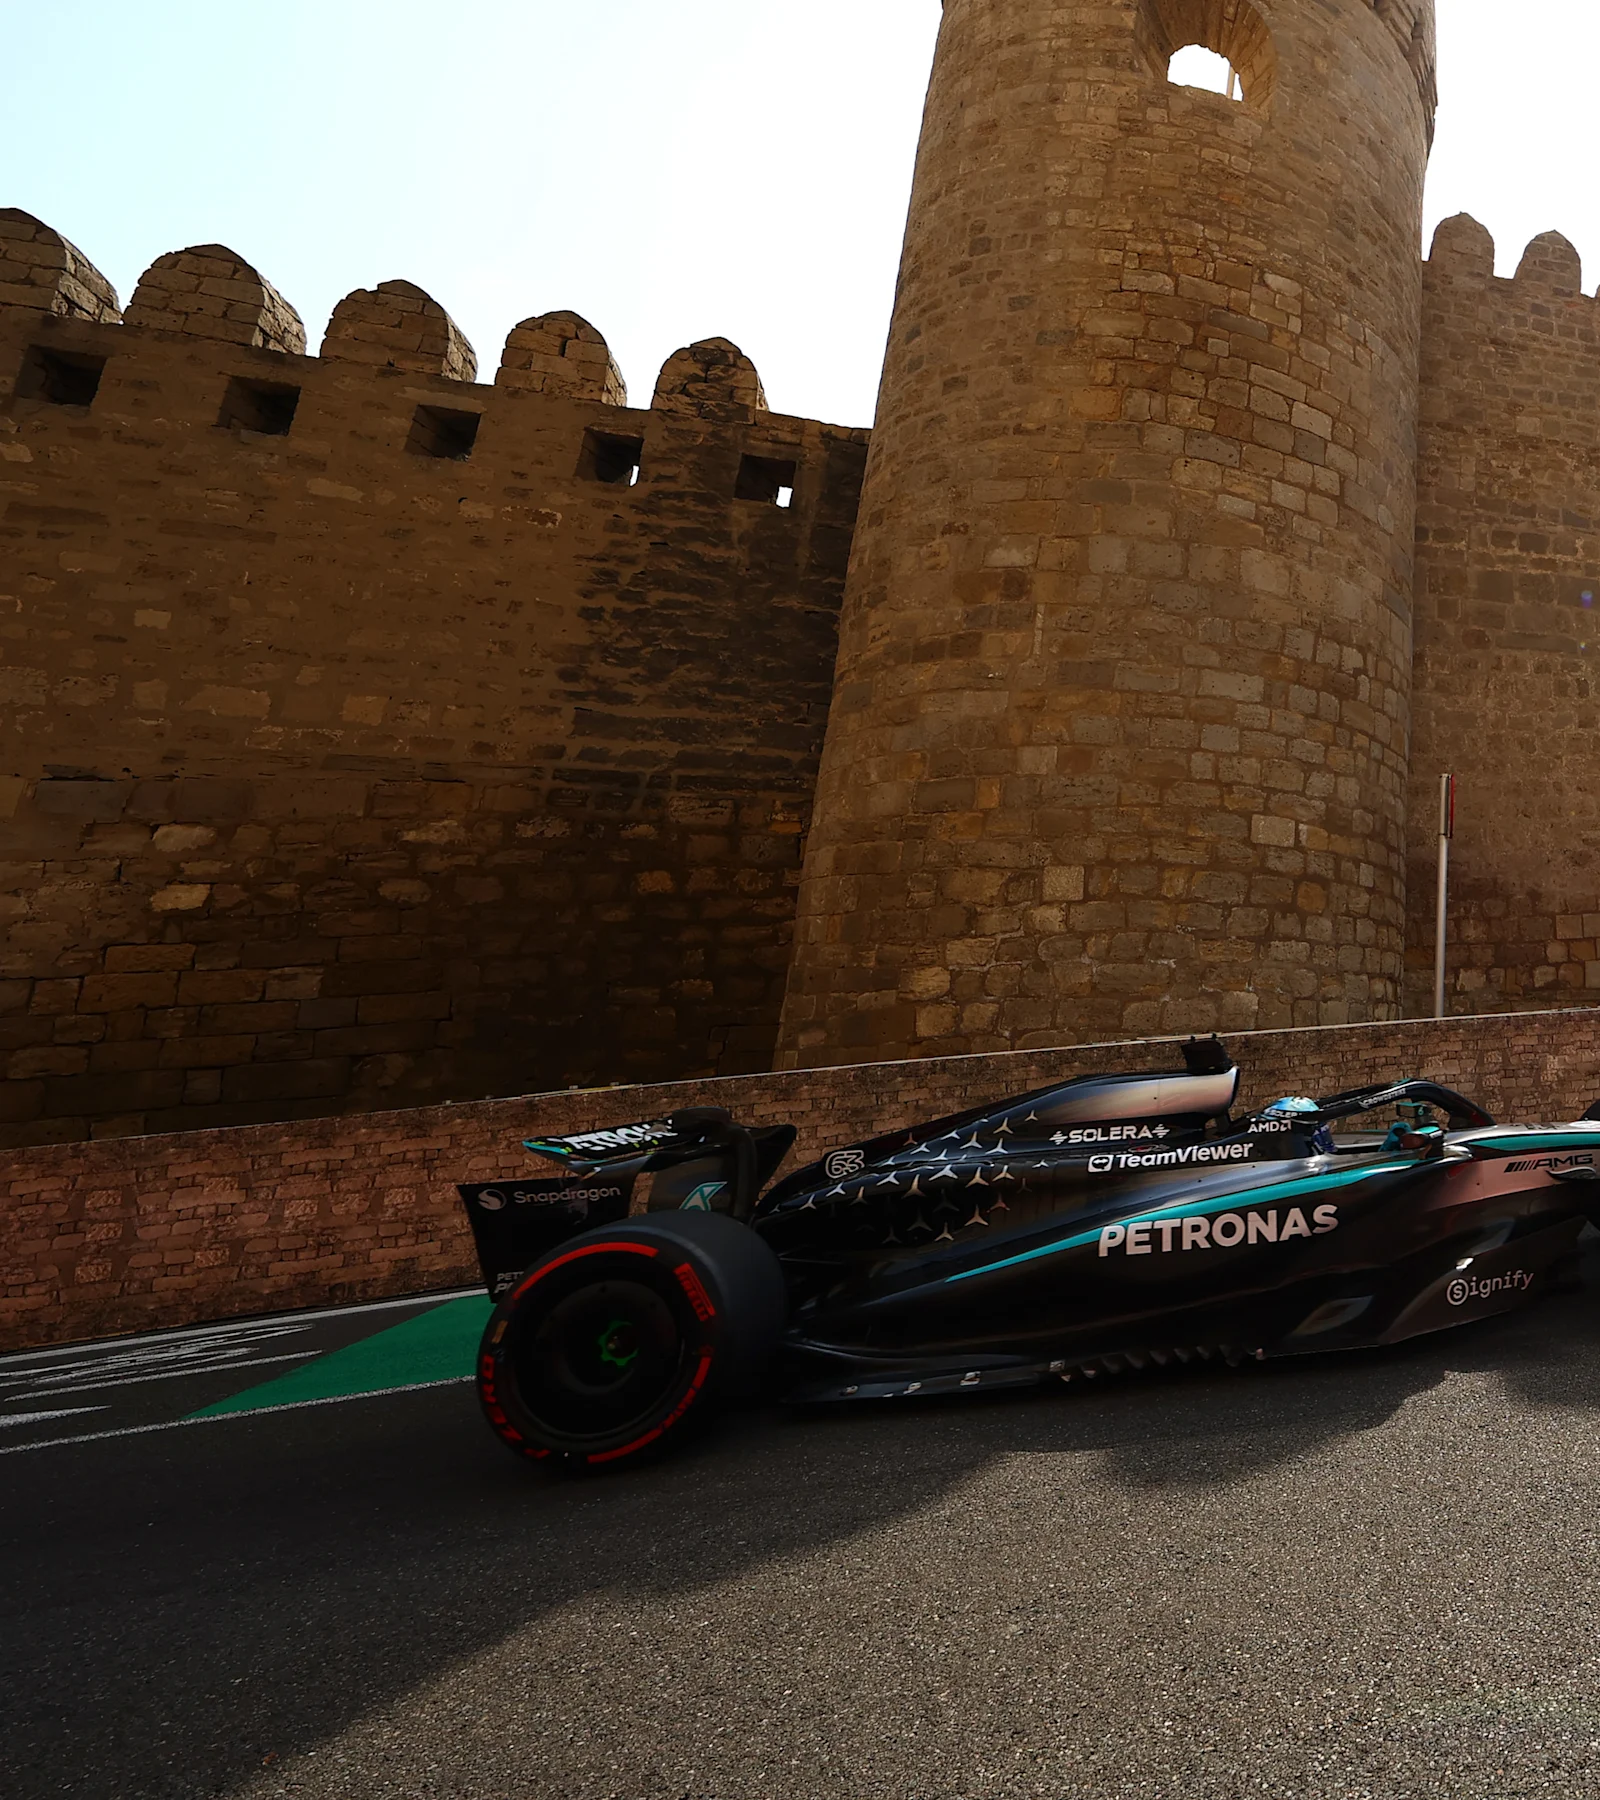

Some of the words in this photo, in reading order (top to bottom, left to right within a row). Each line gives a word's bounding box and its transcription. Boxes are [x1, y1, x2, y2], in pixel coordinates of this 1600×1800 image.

[1067, 1124, 1153, 1144] SOLERA
[1247, 1120, 1281, 1134] AMD
[825, 1149, 865, 1179] 63
[1117, 1142, 1254, 1169] TeamViewer
[1533, 1153, 1593, 1170] AMG
[513, 1185, 621, 1205] Snapdragon
[1098, 1203, 1340, 1258] PETRONAS
